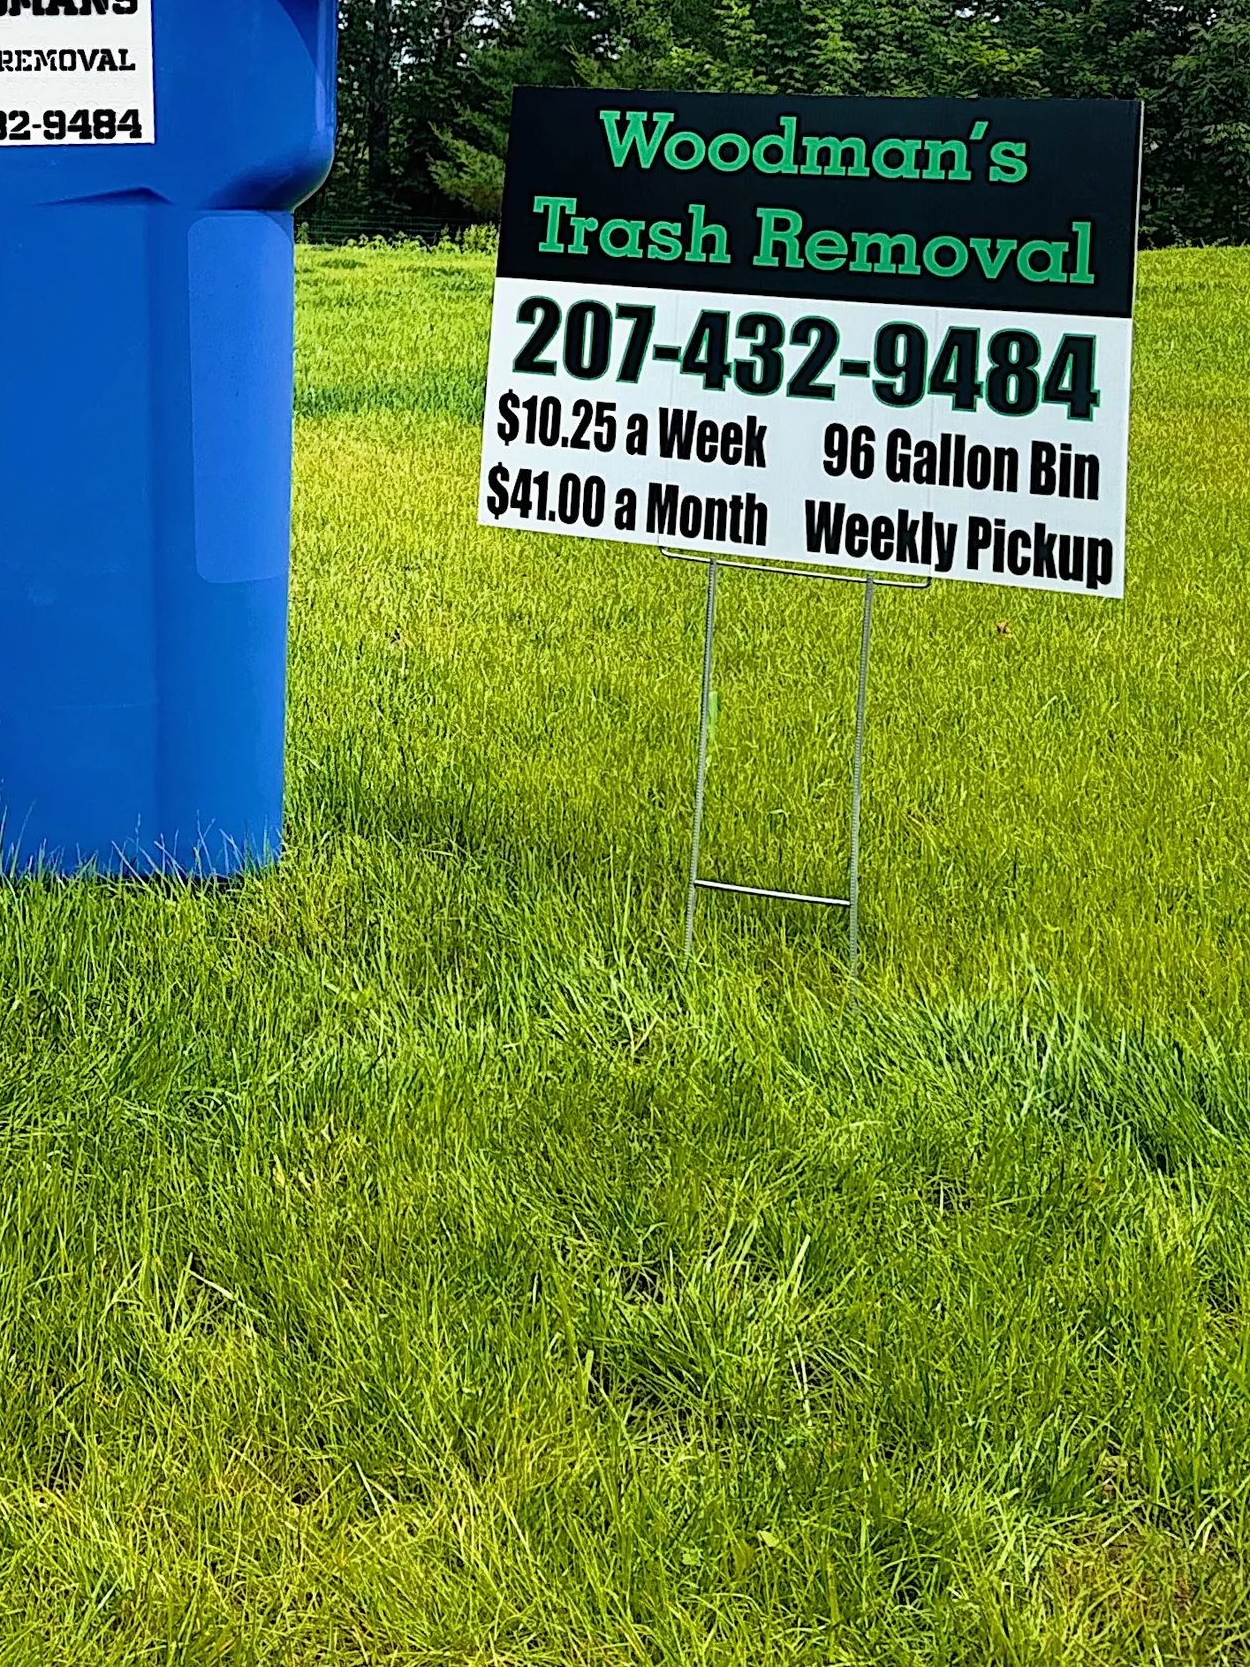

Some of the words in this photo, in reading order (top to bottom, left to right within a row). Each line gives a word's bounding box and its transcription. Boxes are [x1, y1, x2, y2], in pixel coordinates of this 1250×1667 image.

[600, 110, 1028, 183] Woodman's
[533, 196, 731, 263] Trash
[753, 208, 1095, 284] Removal
[512, 296, 1100, 421] 207-432-9484
[497, 390, 617, 452] $10.25
[627, 416, 647, 455] a
[659, 407, 767, 467] Week
[824, 424, 874, 480] 96
[885, 428, 1017, 492] Gallon
[1030, 441, 1099, 499] Bin
[487, 463, 604, 527] $41.00
[615, 492, 635, 531] a
[646, 483, 768, 547] Month
[805, 500, 957, 572] Weekly
[967, 516, 1113, 589] Pickup
